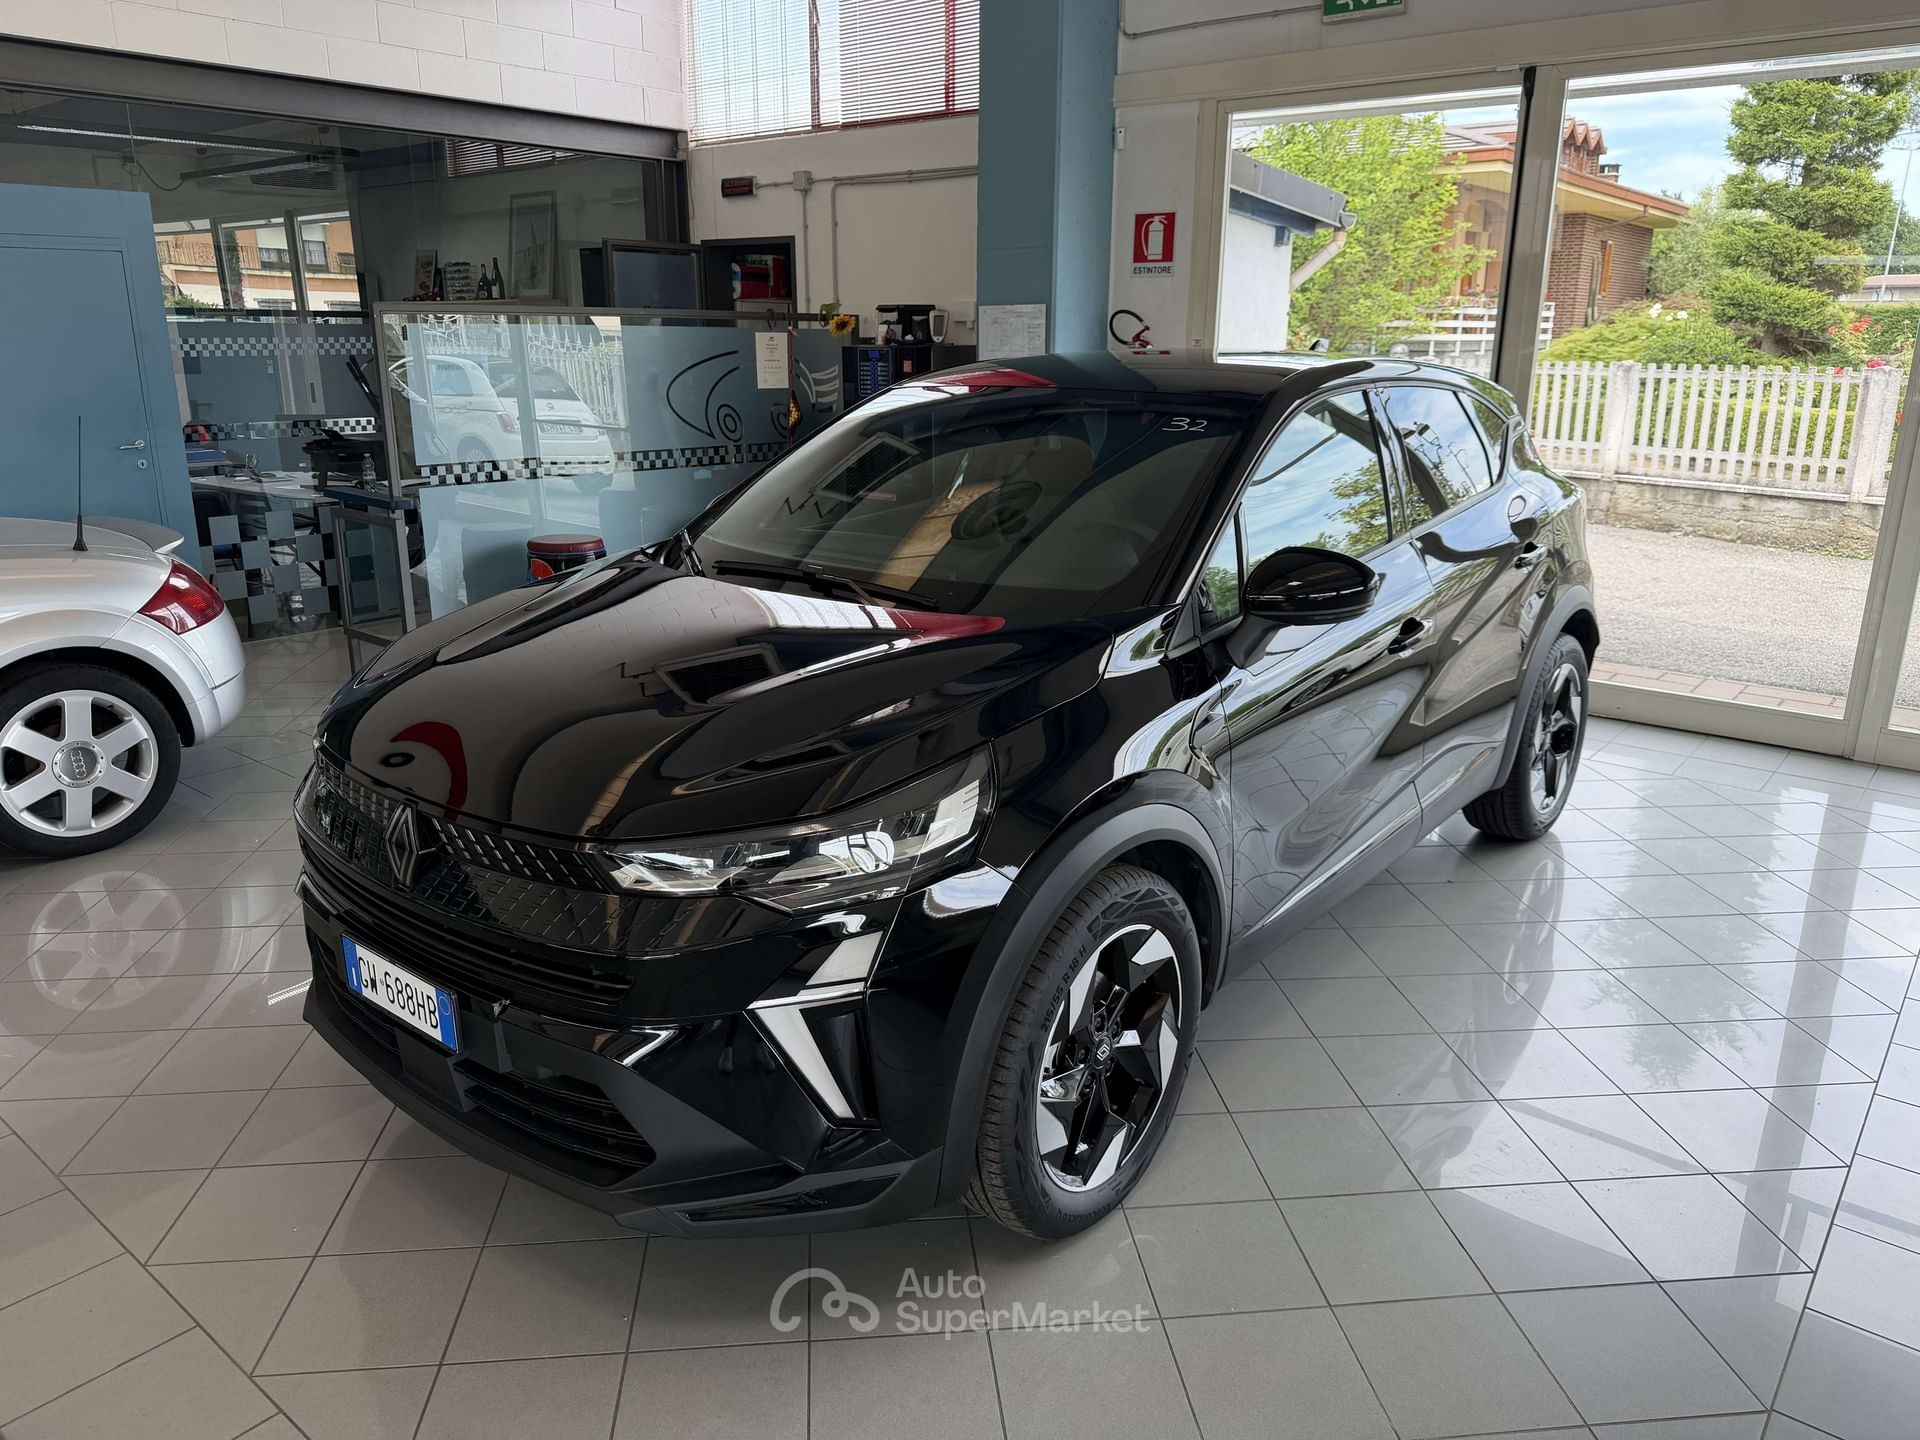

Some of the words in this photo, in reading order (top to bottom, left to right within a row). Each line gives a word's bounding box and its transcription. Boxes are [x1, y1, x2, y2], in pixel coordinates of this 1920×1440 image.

[1133, 266, 1172, 275] ESTINTORE
[1161, 417, 1207, 432] 32
[384, 971, 439, 1029] 688HB
[1041, 985, 1064, 1032] 215/55
[1062, 972, 1070, 984] R
[1069, 957, 1079, 972] 18
[1079, 944, 1087, 957] H
